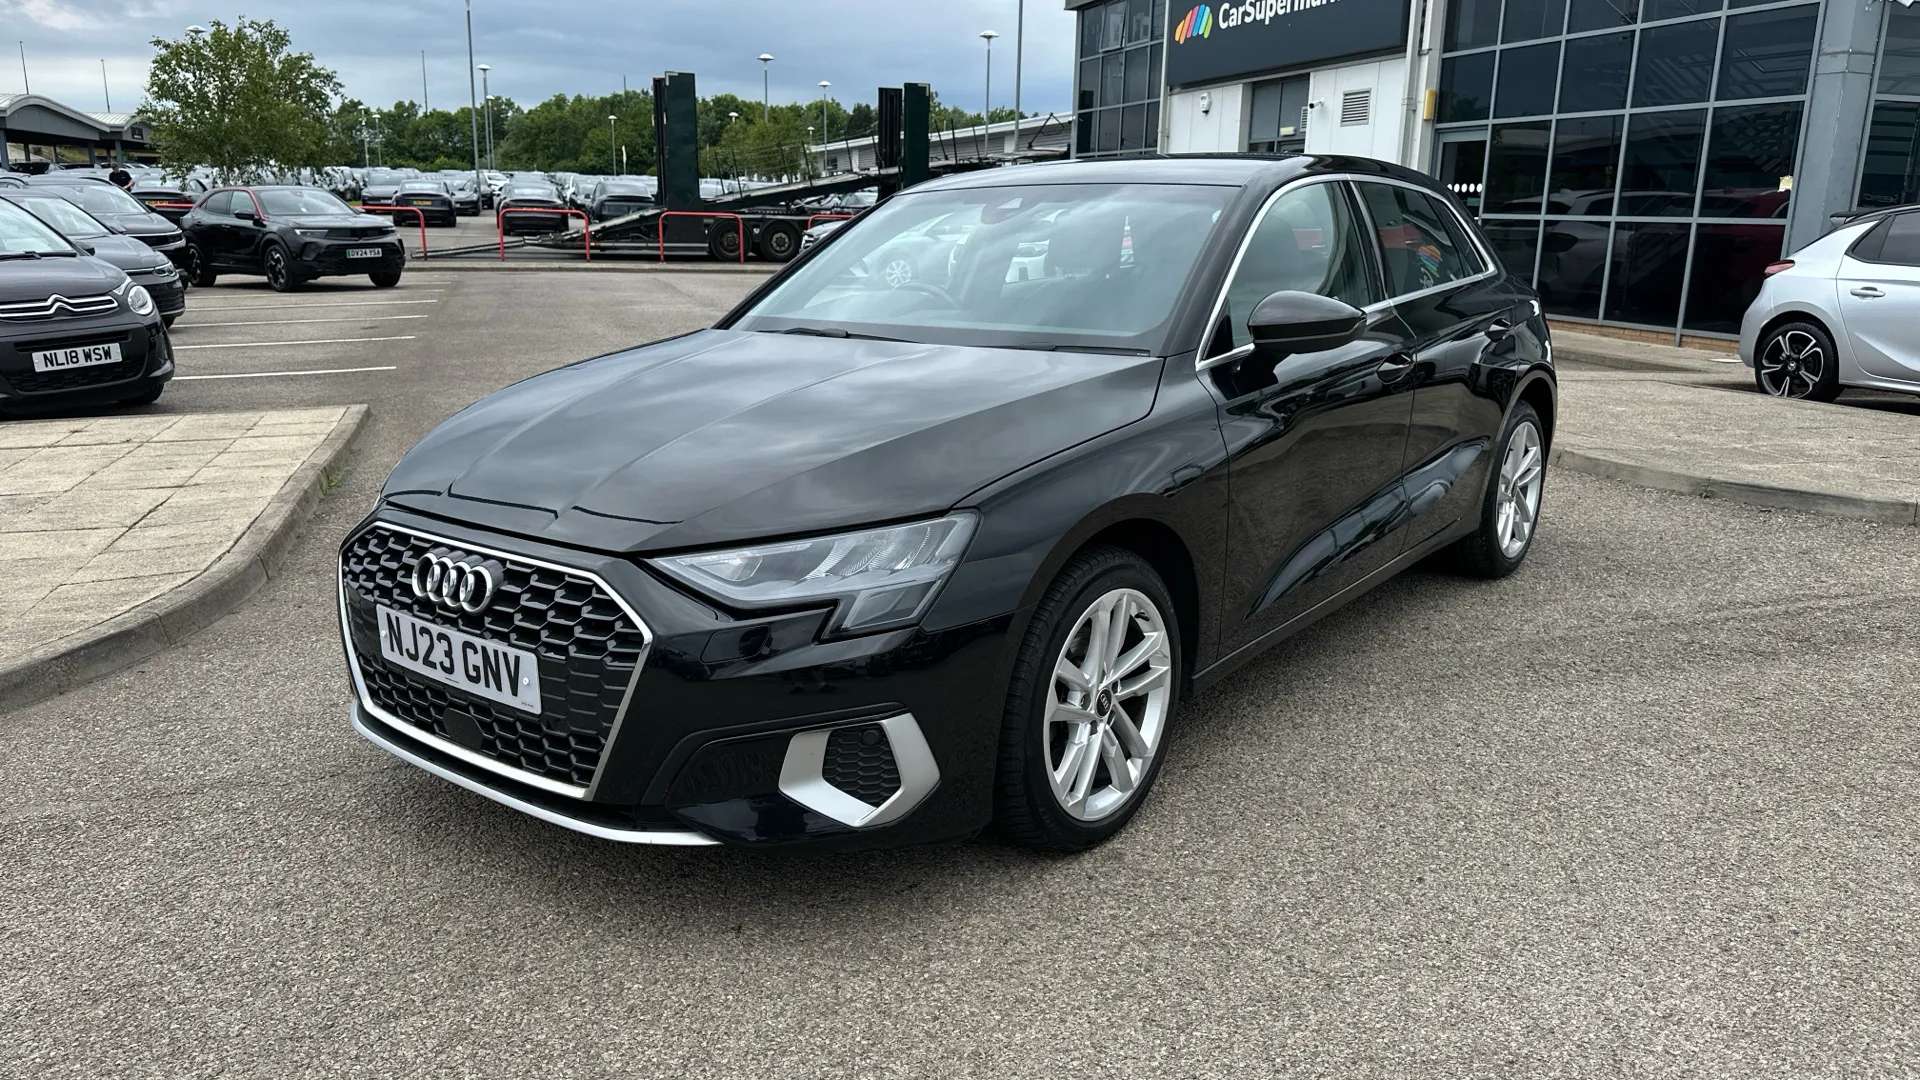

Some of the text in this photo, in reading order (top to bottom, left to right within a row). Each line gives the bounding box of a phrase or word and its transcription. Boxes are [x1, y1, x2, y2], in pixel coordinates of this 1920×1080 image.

[42, 346, 112, 368] NL18 WSW
[385, 612, 520, 697] NJ23 GNV
